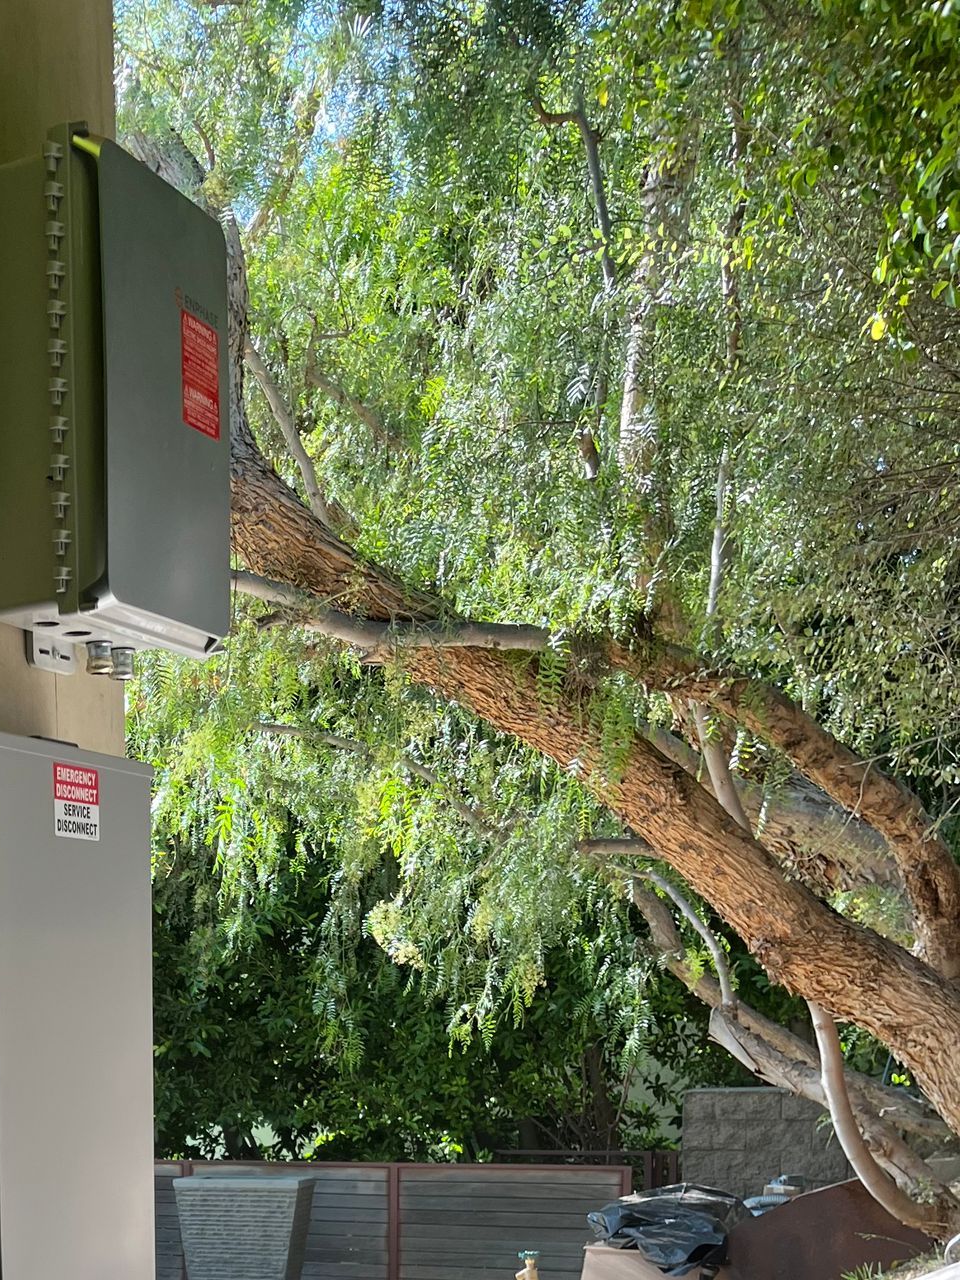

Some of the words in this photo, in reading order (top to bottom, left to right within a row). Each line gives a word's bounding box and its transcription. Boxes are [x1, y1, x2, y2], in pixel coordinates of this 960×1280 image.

[56, 766, 96, 787] EMERGENCY
[56, 783, 97, 803] DISCONNECT
[63, 803, 91, 820] SERVICE
[57, 818, 98, 837] DISCONNECT
